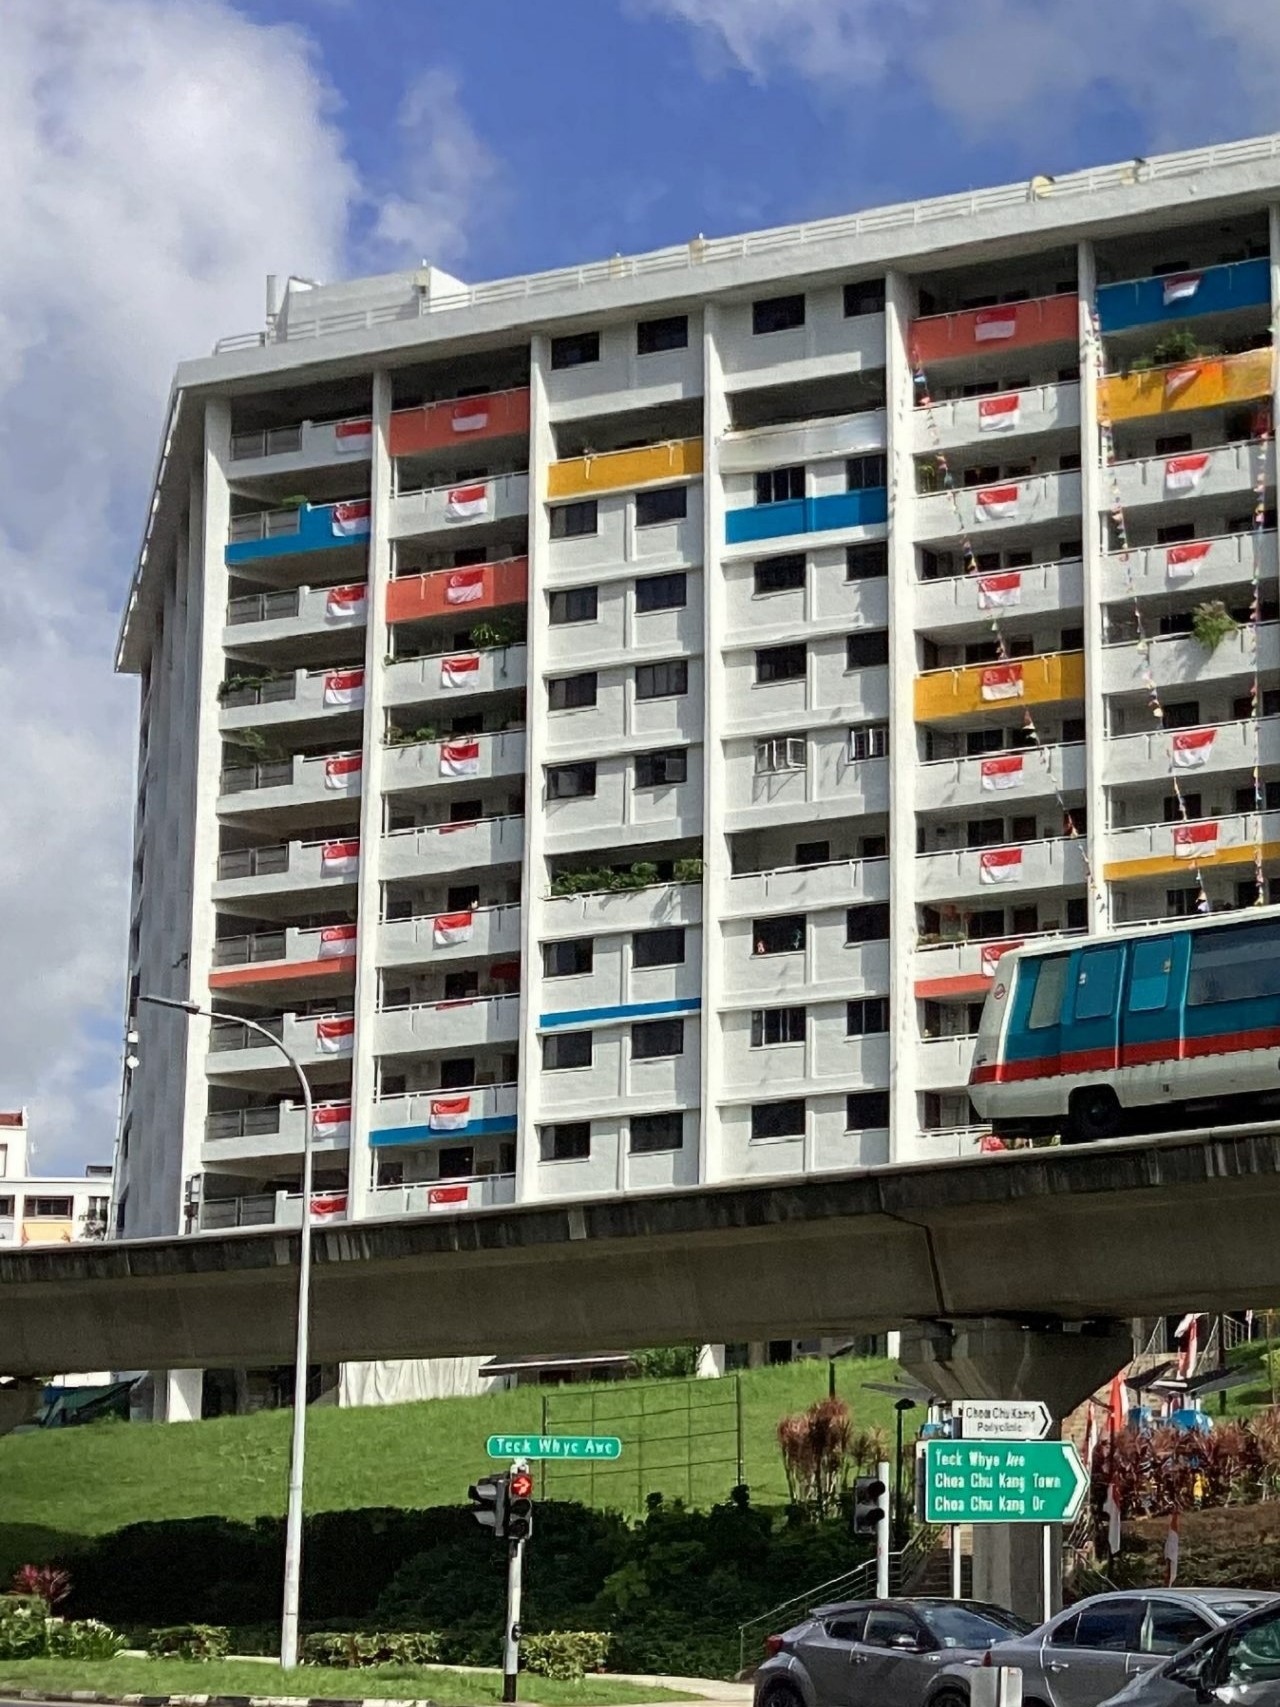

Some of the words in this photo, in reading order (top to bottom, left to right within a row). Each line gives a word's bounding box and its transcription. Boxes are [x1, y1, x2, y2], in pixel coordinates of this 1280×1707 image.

[966, 1407, 991, 1419] Choa
[992, 1407, 1010, 1419] Chu
[1011, 1408, 1036, 1421] Kang
[977, 1422, 1023, 1433] Polyclinic
[497, 1439, 531, 1453] Teck
[539, 1439, 578, 1456] Whye
[585, 1440, 612, 1454] Ave
[935, 1449, 962, 1466] Teck
[969, 1450, 1000, 1470] Whye
[1006, 1451, 1025, 1466] Ave
[935, 1473, 965, 1488] Choa
[971, 1473, 993, 1488] Chu
[999, 1473, 1025, 1493] Kang
[1033, 1473, 1061, 1488] Town
[935, 1496, 965, 1512] Choa
[971, 1496, 993, 1511] Chu
[999, 1496, 1025, 1516] Kang
[1033, 1496, 1046, 1511] Dr
